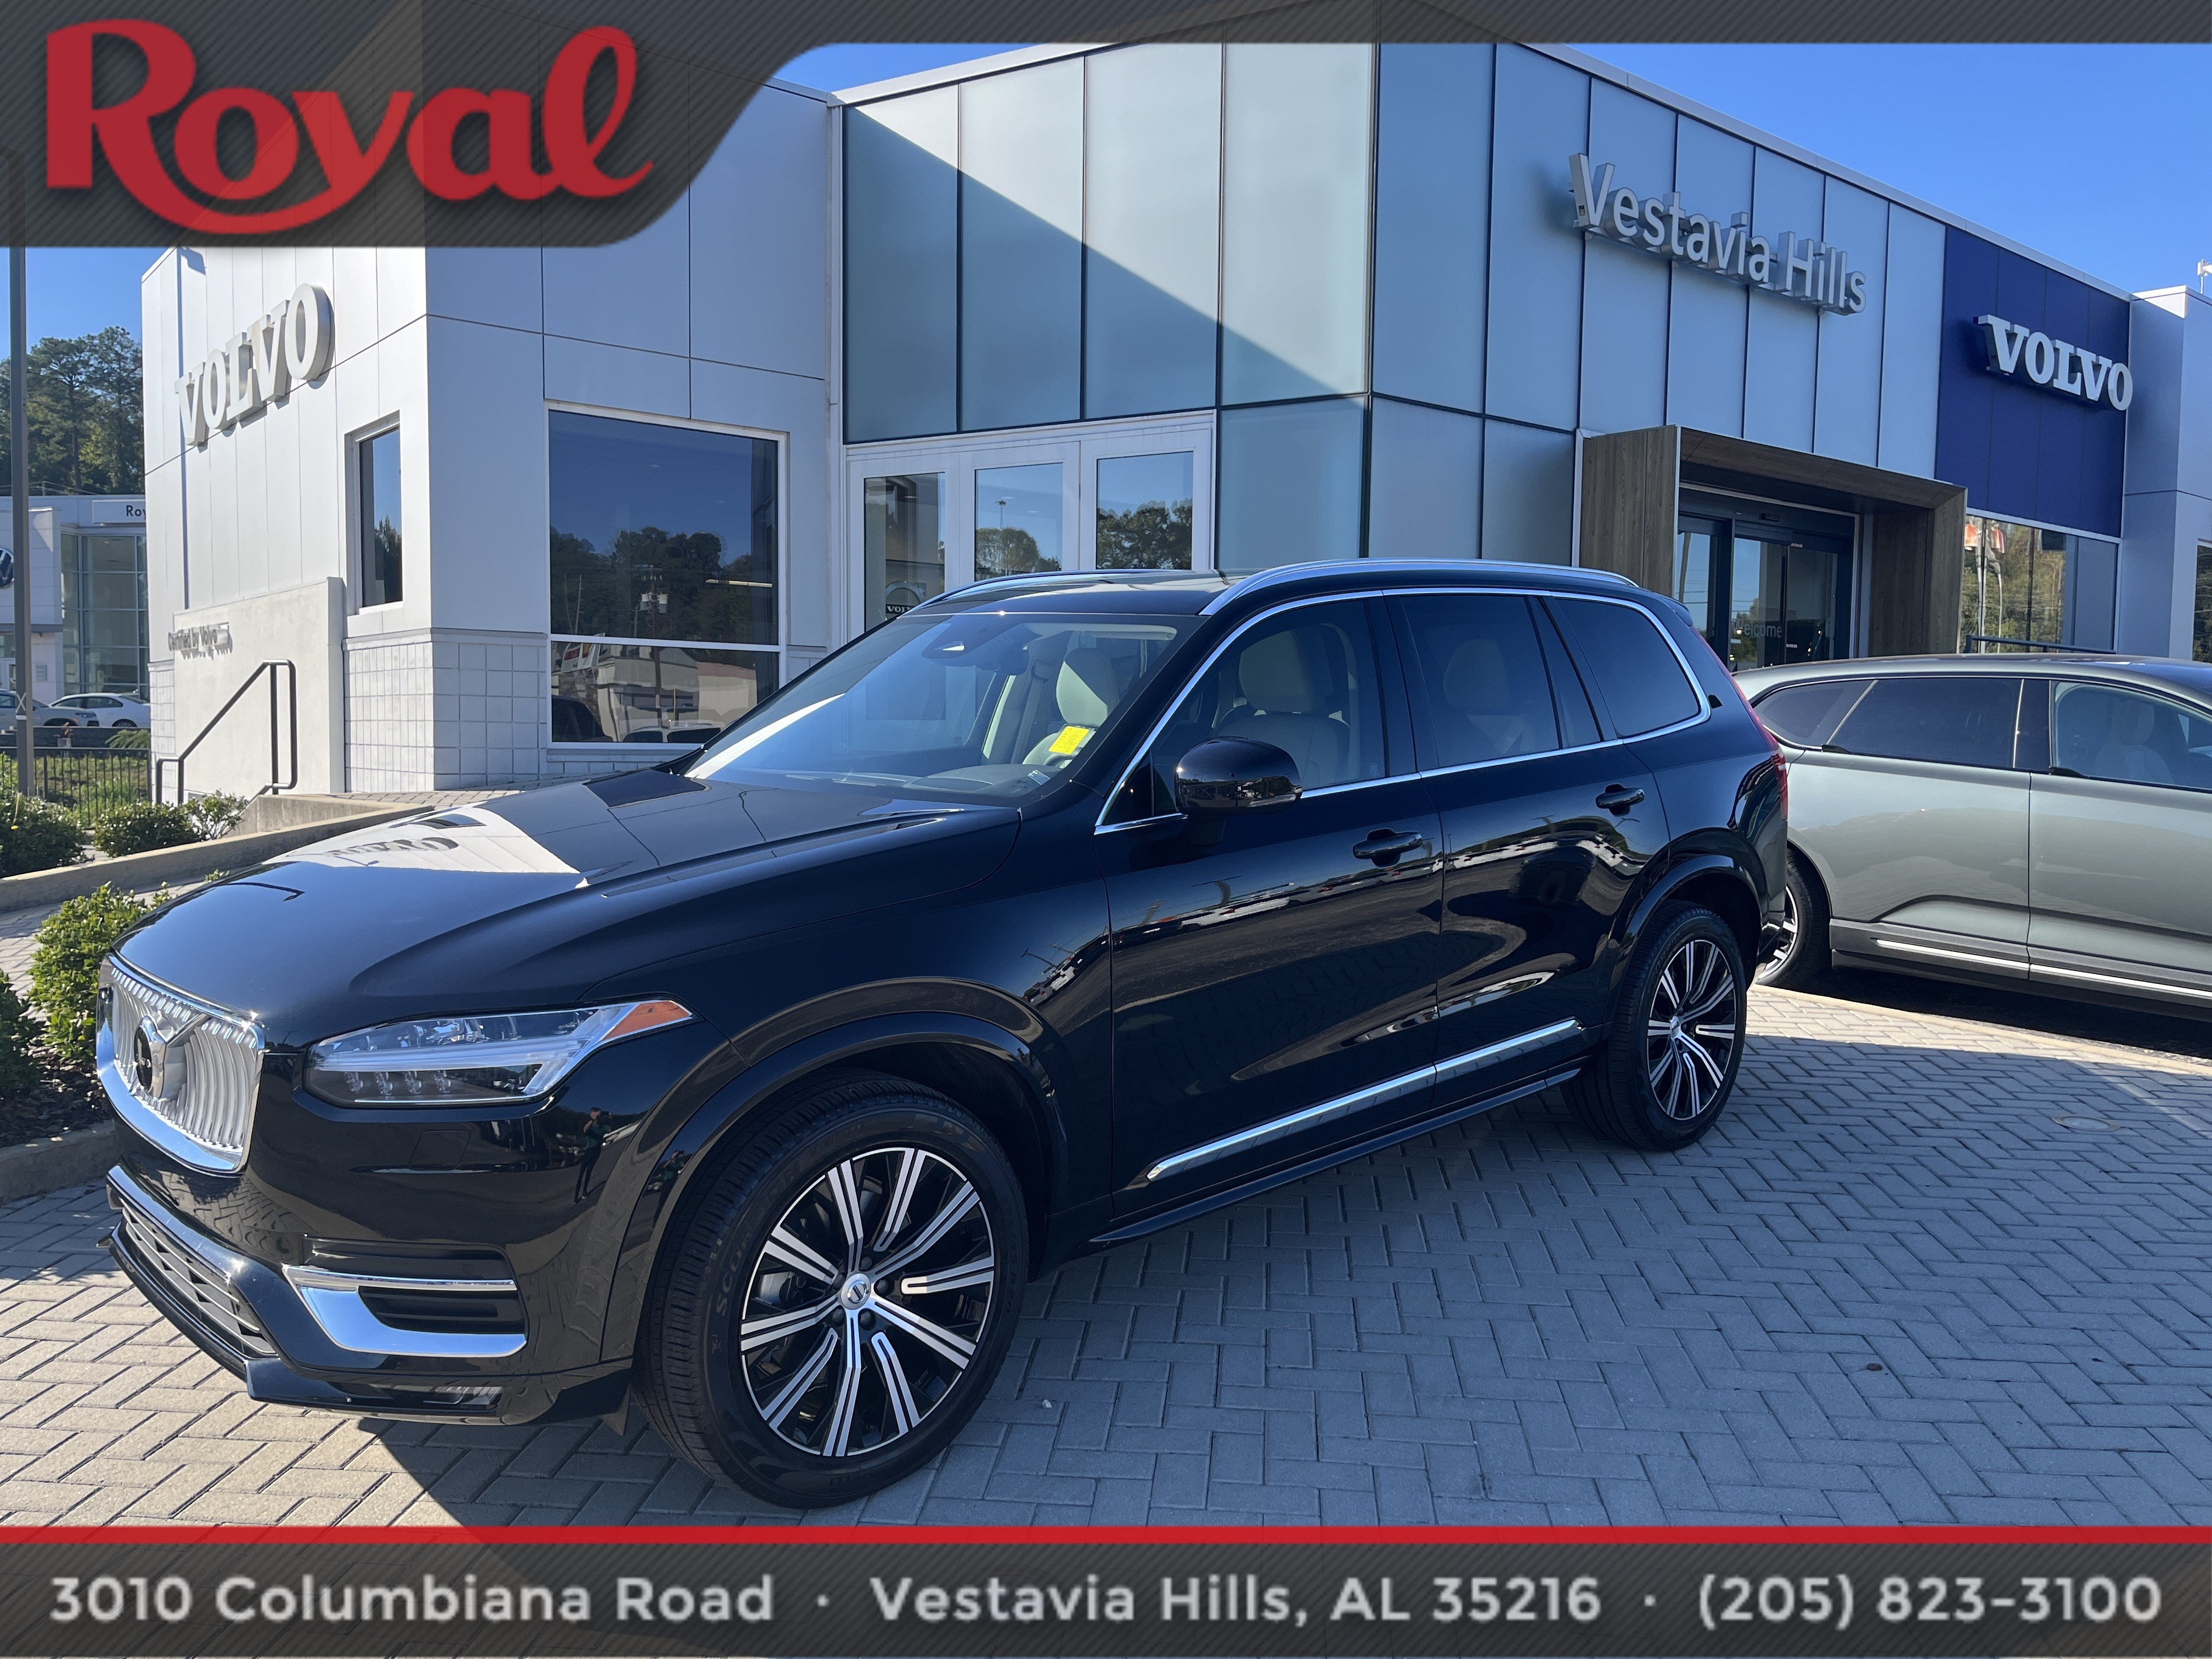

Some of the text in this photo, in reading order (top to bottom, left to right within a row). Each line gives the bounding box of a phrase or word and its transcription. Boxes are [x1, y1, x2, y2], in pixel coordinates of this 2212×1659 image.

[1568, 153, 1866, 314] Vestavia Hills
[174, 283, 328, 446] VOLVO
[1978, 314, 2133, 411] VOLVO
[1732, 617, 1782, 638] Welcome
